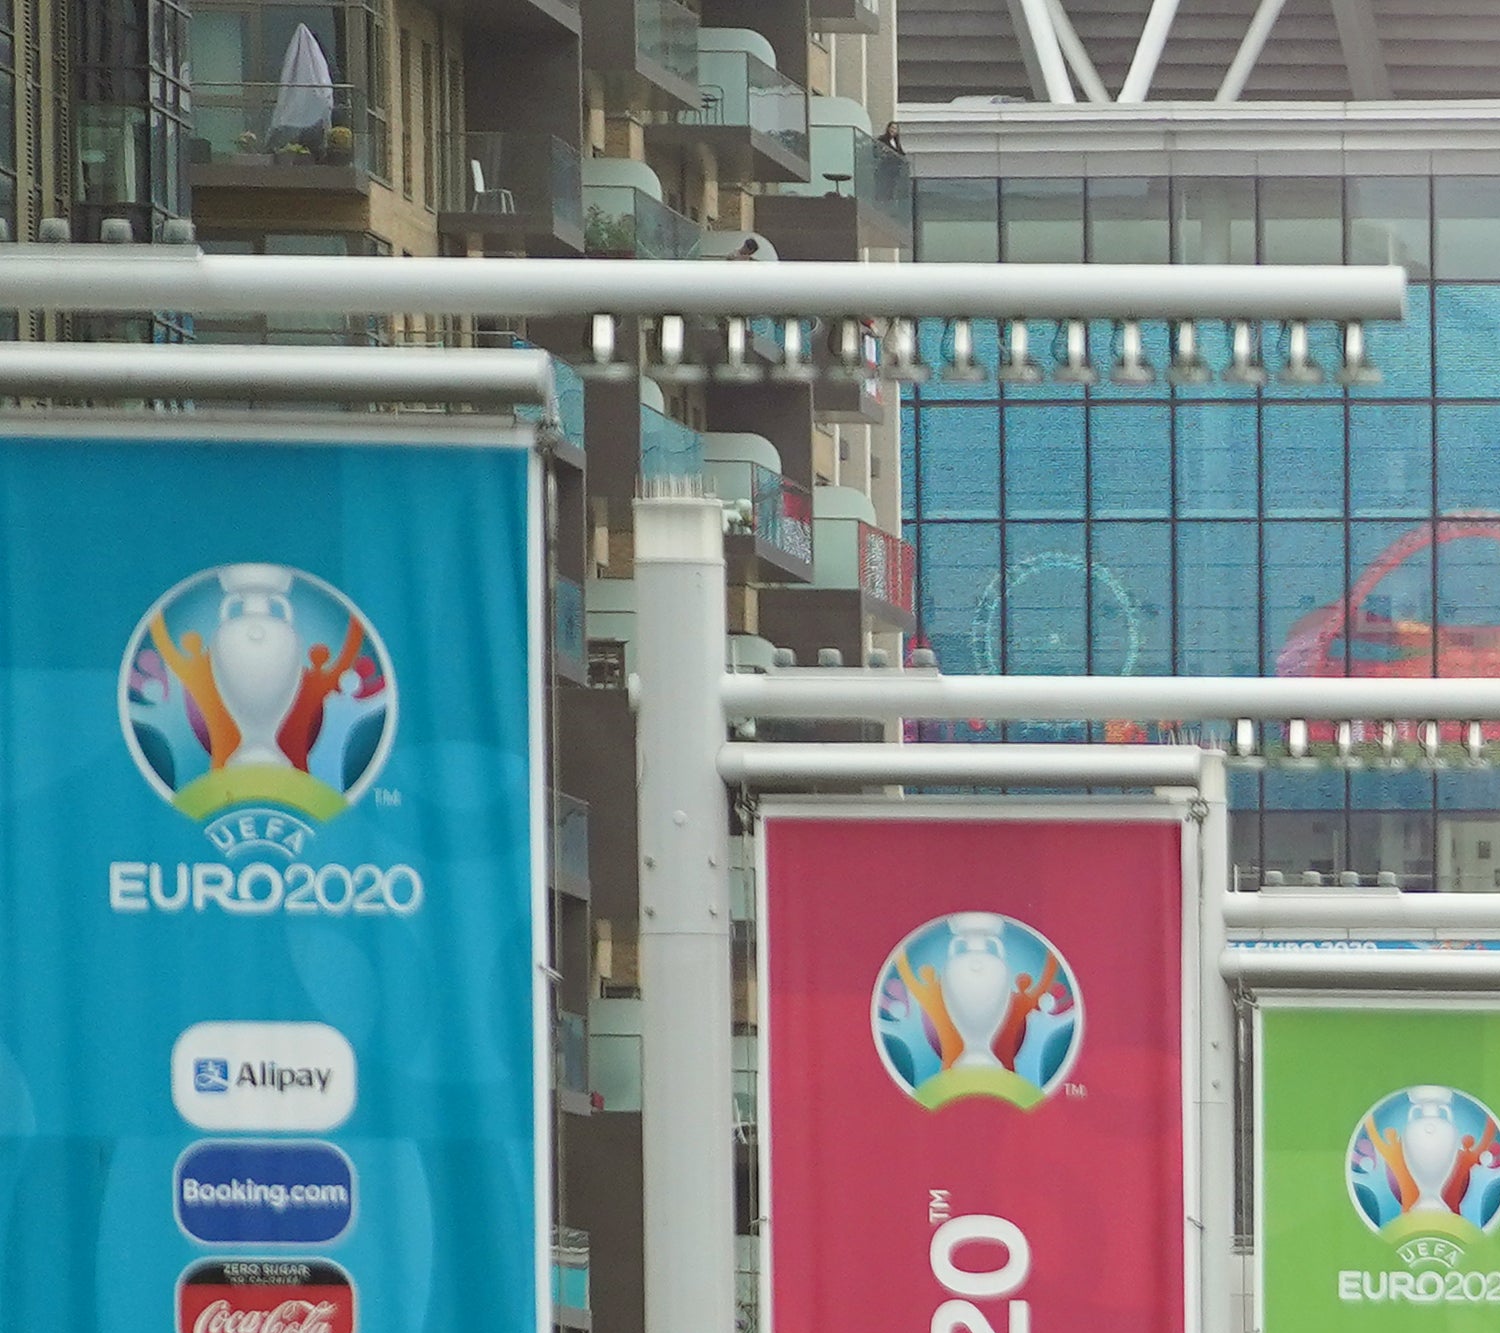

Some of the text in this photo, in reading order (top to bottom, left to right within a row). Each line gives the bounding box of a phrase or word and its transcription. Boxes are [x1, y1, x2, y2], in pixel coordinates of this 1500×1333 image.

[208, 816, 308, 856] UEFA
[236, 1060, 333, 1092] Alipay
[183, 1178, 347, 1208] Booking.com
[1399, 1242, 1460, 1267] UEFA
[223, 1264, 260, 1276] ZERO
